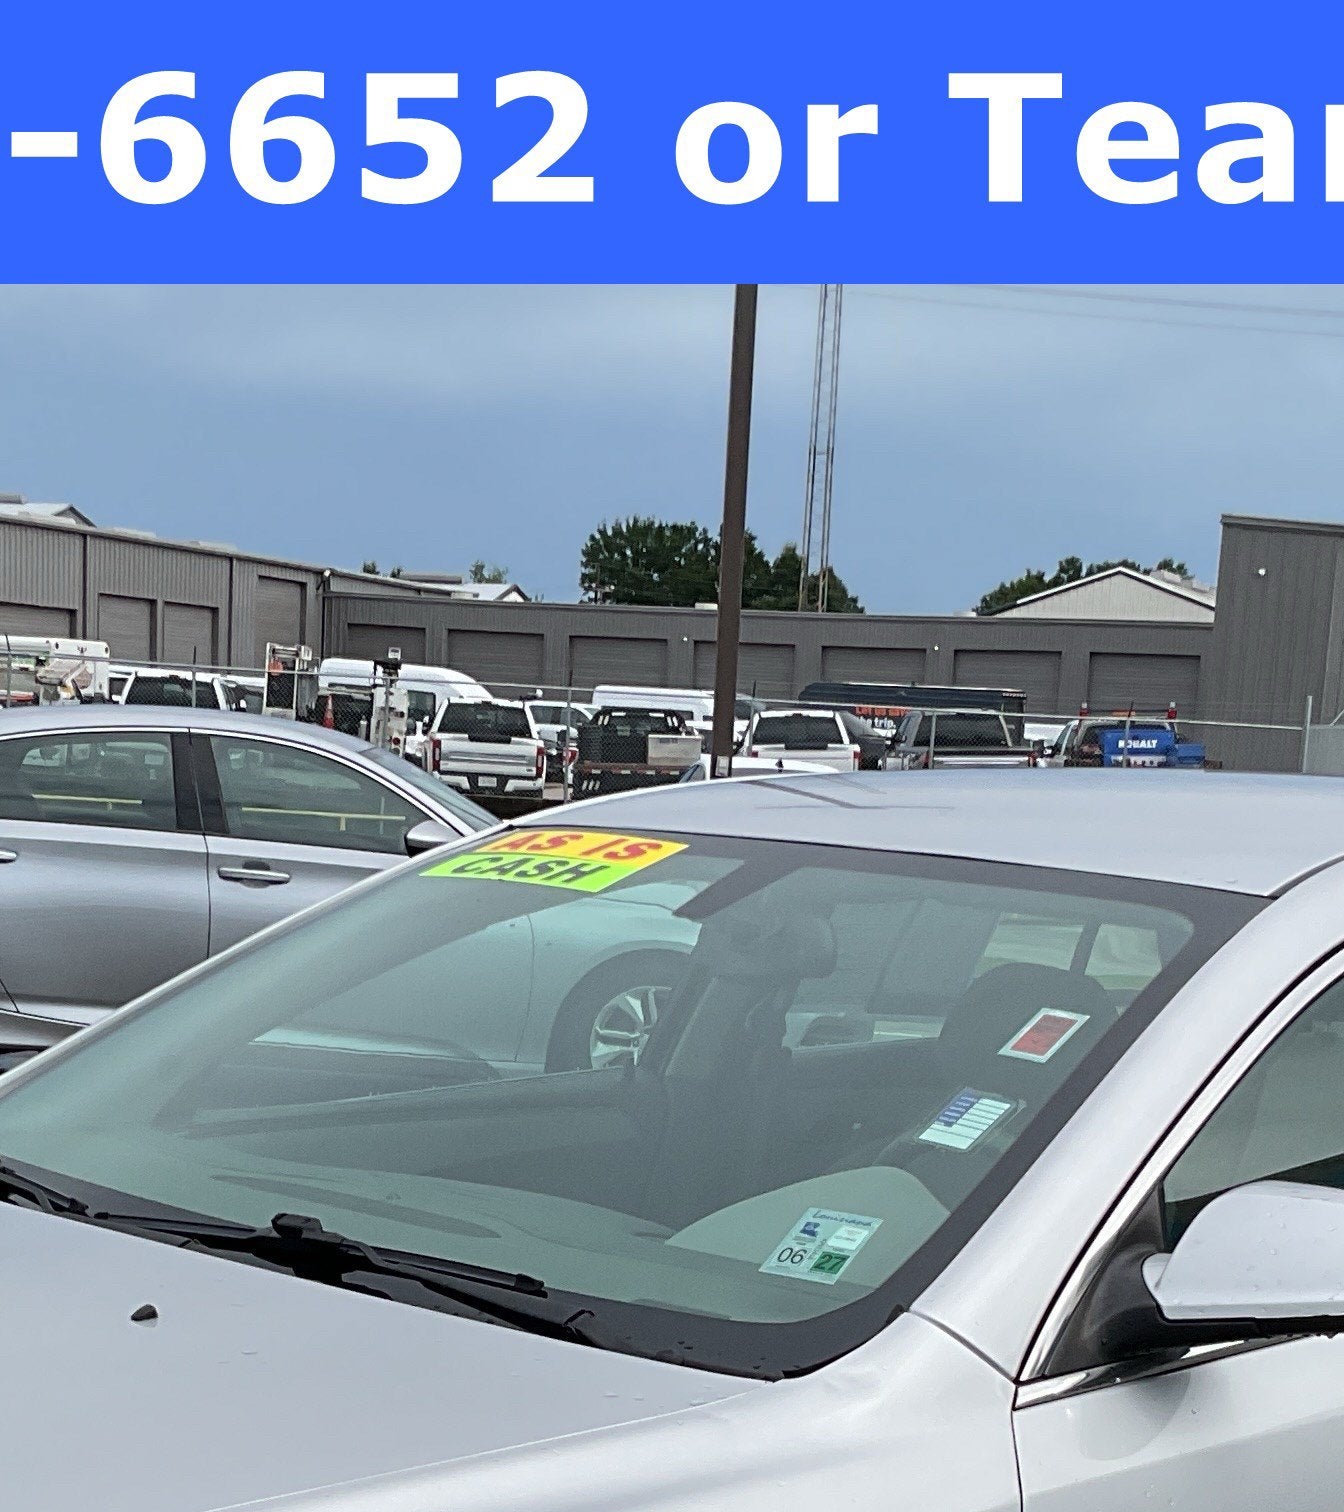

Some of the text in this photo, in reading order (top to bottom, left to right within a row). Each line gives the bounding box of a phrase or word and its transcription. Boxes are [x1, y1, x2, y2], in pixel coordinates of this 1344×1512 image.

[492, 832, 663, 861] AS IS
[451, 856, 611, 884] CASH
[776, 1247, 807, 1265] 06
[813, 1253, 847, 1271] 27
